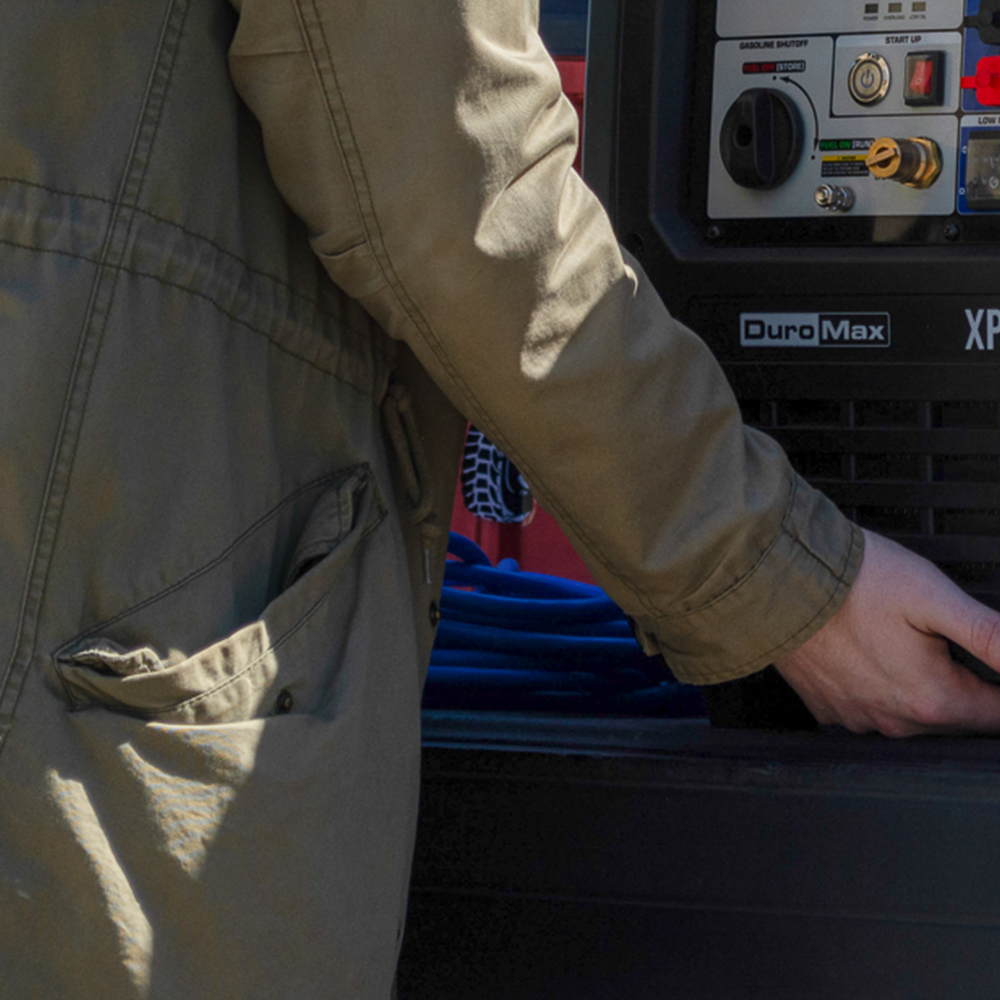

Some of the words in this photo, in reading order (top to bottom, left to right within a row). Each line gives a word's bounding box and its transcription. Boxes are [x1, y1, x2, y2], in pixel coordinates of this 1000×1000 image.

[739, 41, 775, 50] GASOLINE
[776, 39, 808, 49] SHUTOFF
[885, 36, 905, 45] START
[978, 116, 996, 125] LOW
[743, 317, 886, 341] DuroMax
